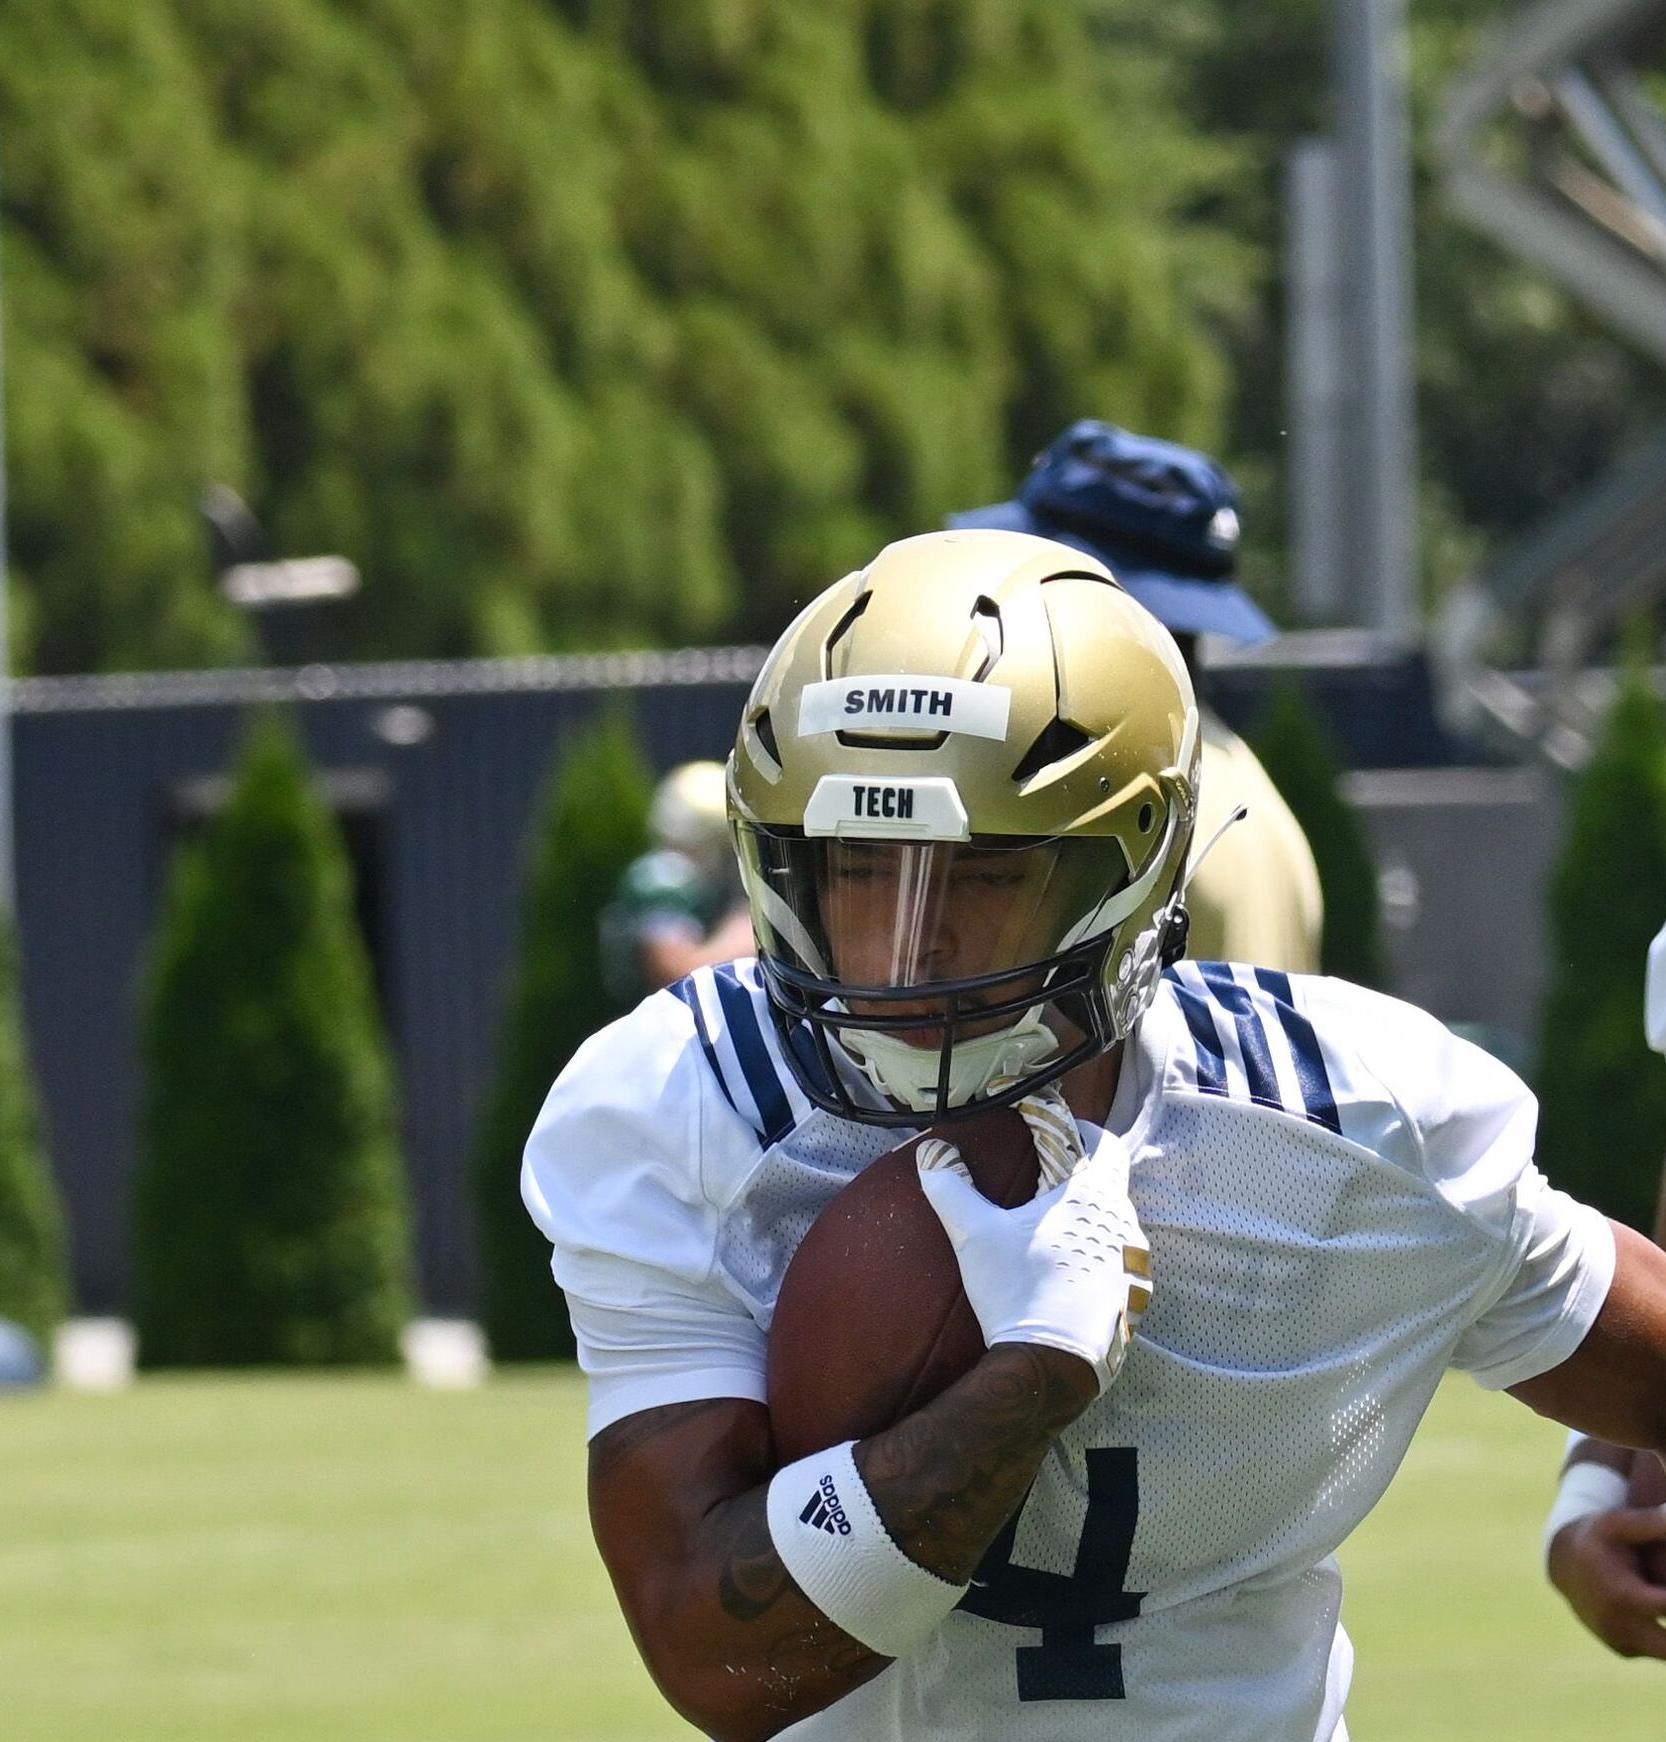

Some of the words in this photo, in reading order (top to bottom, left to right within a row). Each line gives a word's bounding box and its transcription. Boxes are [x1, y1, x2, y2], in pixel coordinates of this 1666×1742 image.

[844, 689, 953, 716] SMITH
[853, 786, 913, 818] TECH
[819, 1474, 852, 1536] adidas
[951, 1446, 1149, 1702] 4
